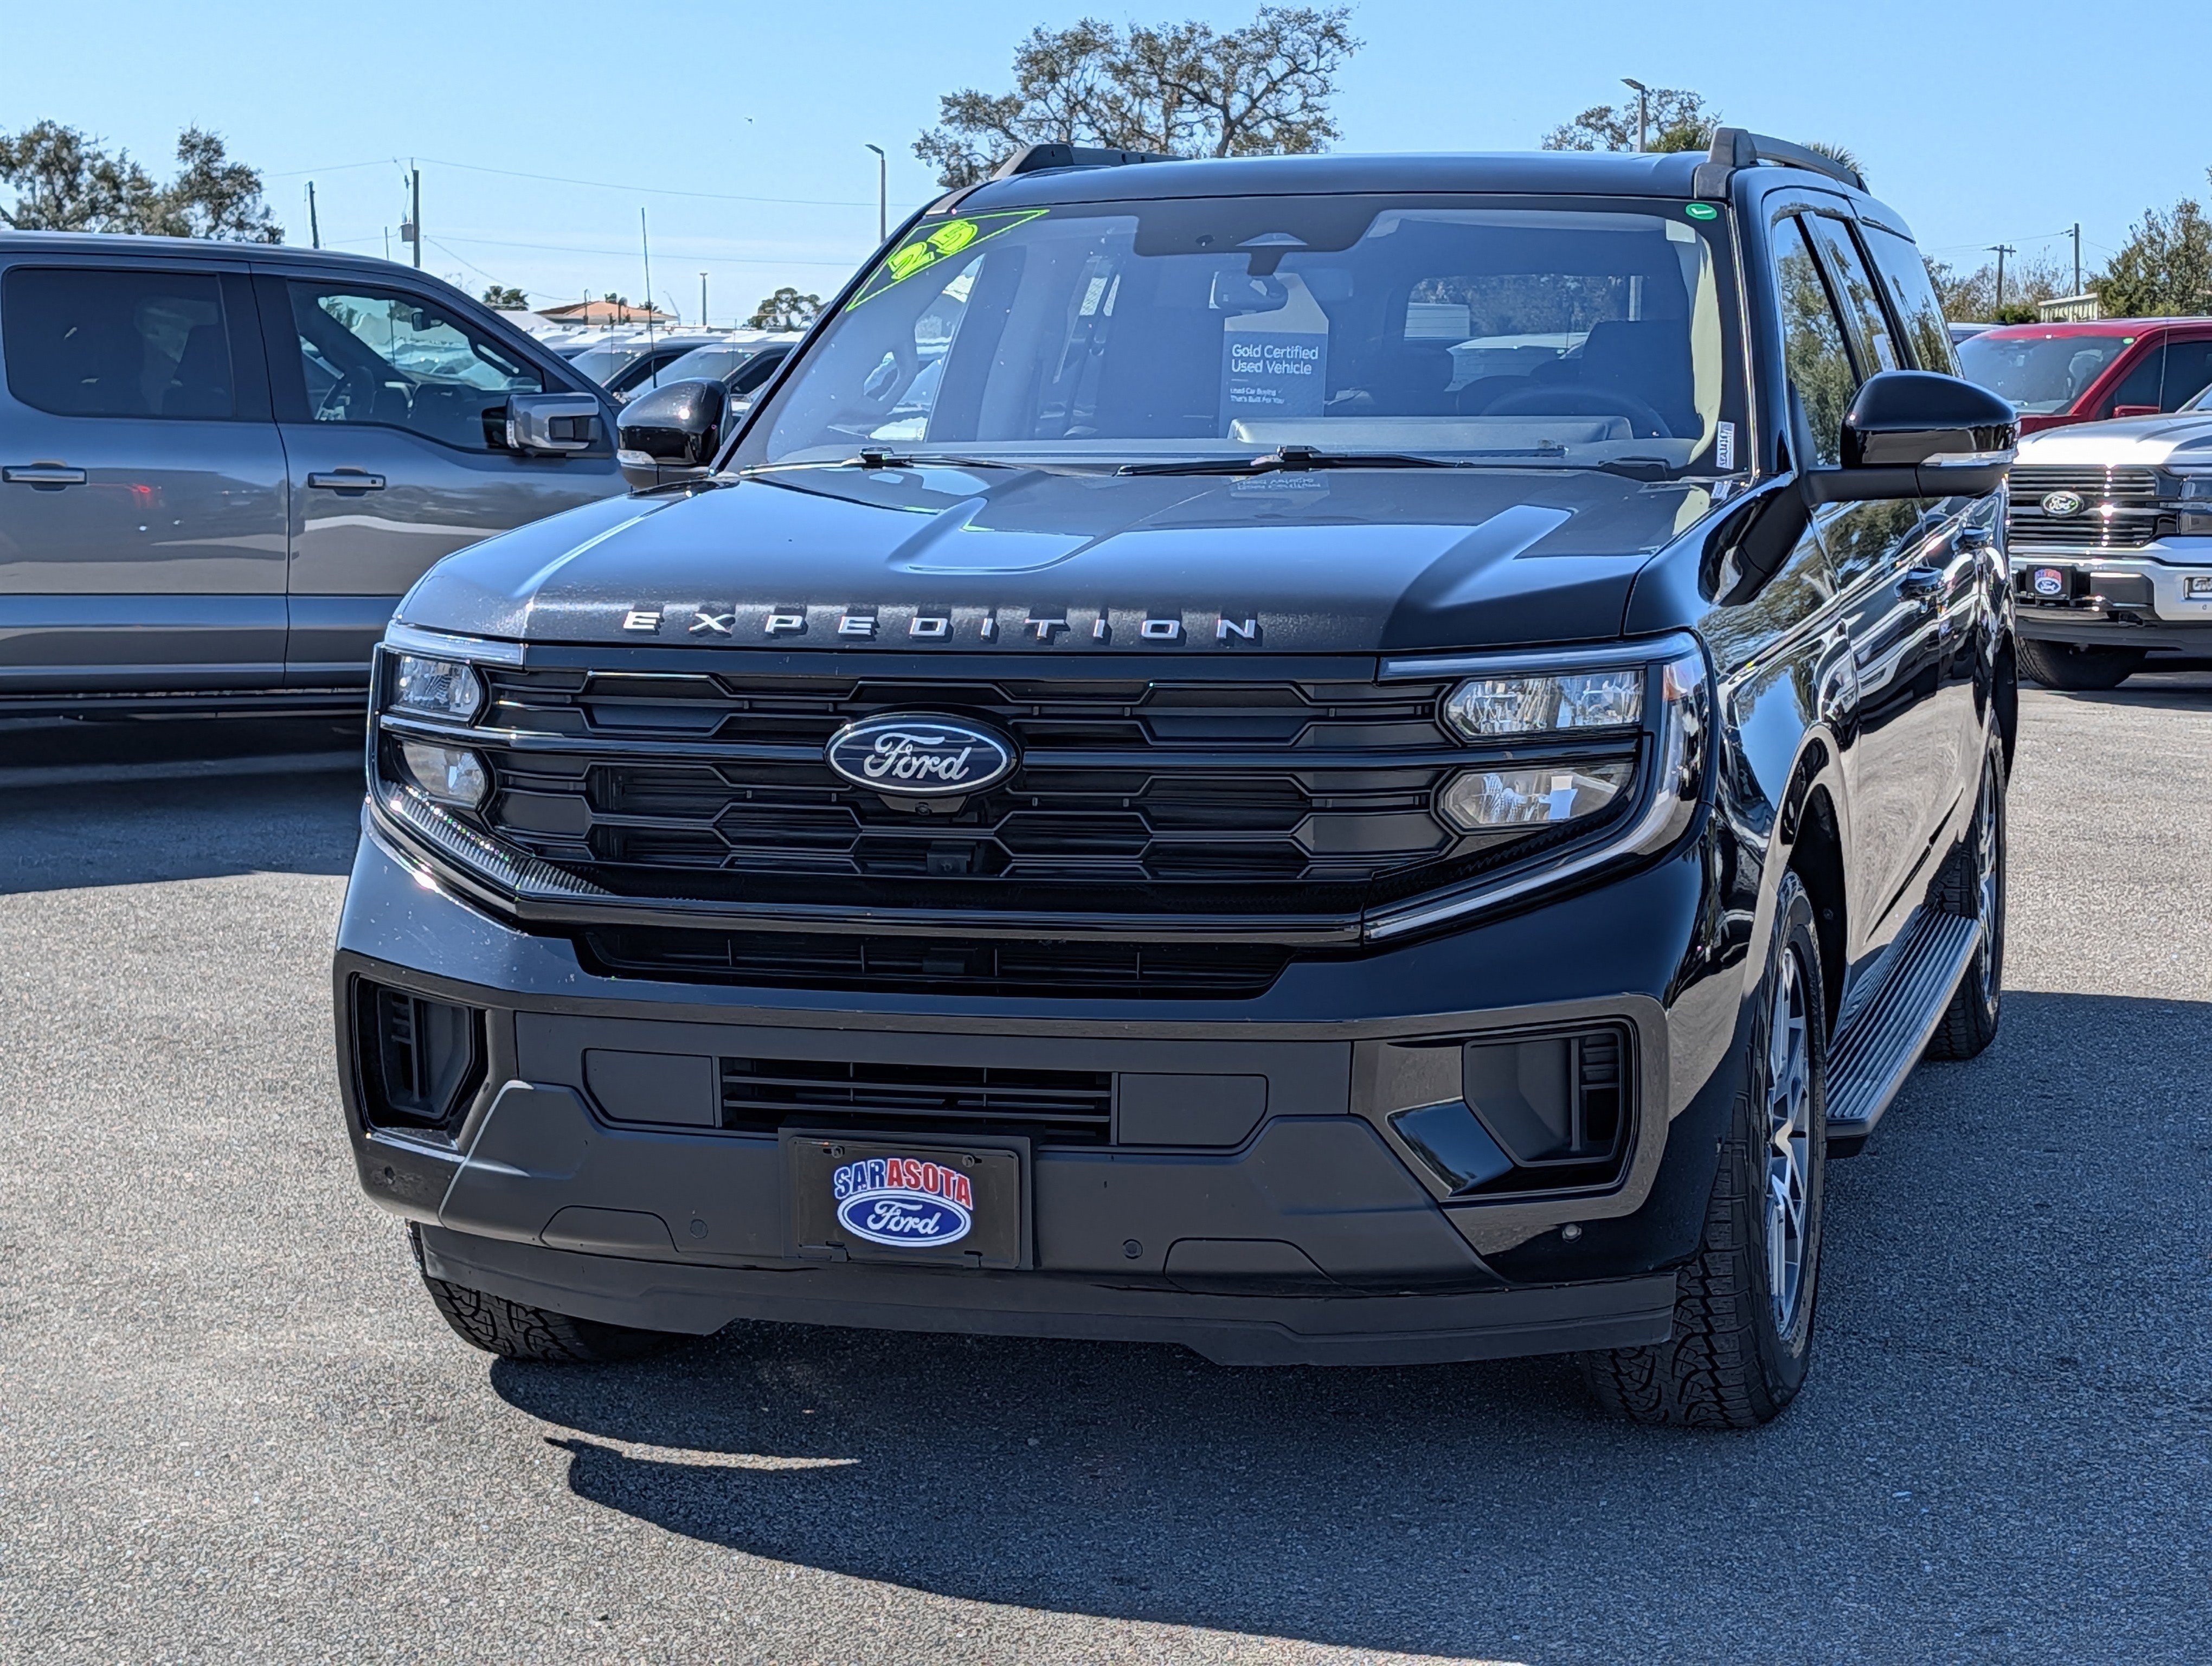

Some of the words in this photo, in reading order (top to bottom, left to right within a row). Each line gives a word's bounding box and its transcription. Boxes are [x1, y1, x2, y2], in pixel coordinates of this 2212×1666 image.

[887, 219, 978, 280] 25
[1231, 358, 1263, 373] Used
[1266, 360, 1312, 374] Vehicle
[1232, 344, 1262, 357] Gold
[1264, 345, 1319, 360] Certified
[623, 608, 1257, 640] EXPEDITION
[864, 732, 972, 780] Ford
[834, 1158, 973, 1210] SARASOTA
[867, 1200, 941, 1234] Ford
